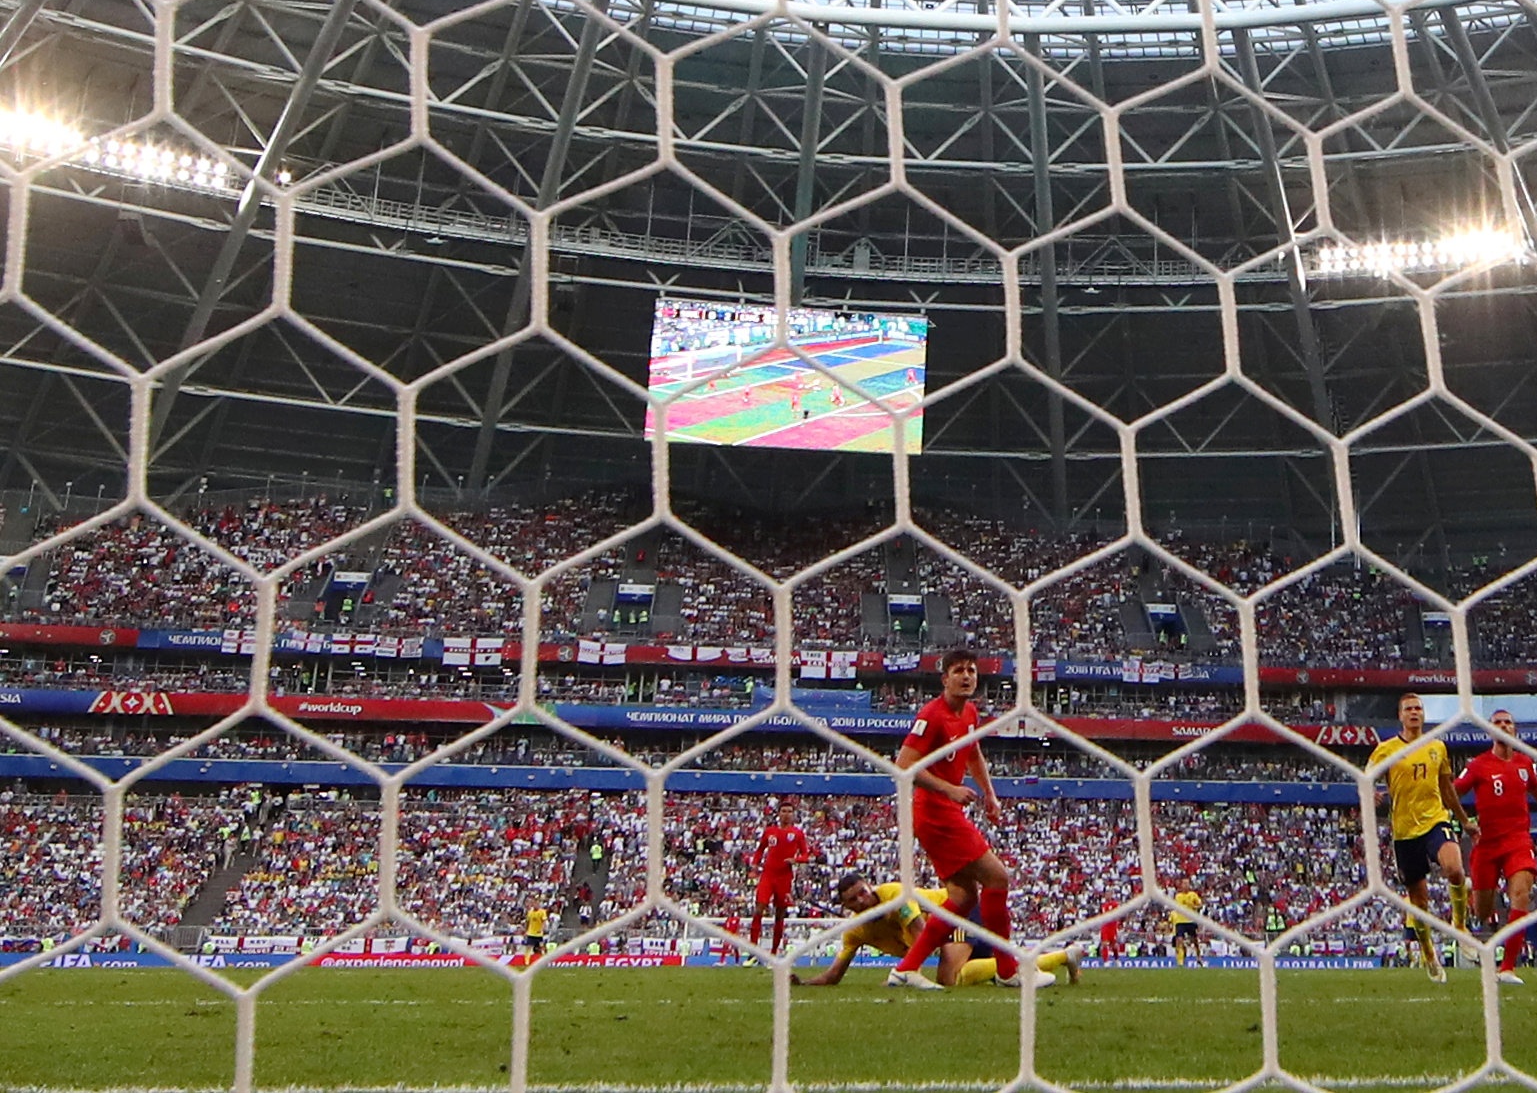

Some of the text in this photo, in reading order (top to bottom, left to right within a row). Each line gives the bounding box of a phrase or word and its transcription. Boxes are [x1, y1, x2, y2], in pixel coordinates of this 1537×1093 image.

[1065, 664, 1088, 675] 2018
[1089, 664, 1111, 675] FIFA
[298, 701, 362, 715] #worldcup
[626, 711, 696, 723] ЧЕМПИОНАТ
[699, 714, 731, 724] МИРА
[831, 717, 856, 727] 2018
[1493, 779, 1504, 796] 8
[604, 956, 663, 967] EGYPT
[1222, 959, 1259, 968] LIVIN
[1352, 959, 1374, 968] FIFA
